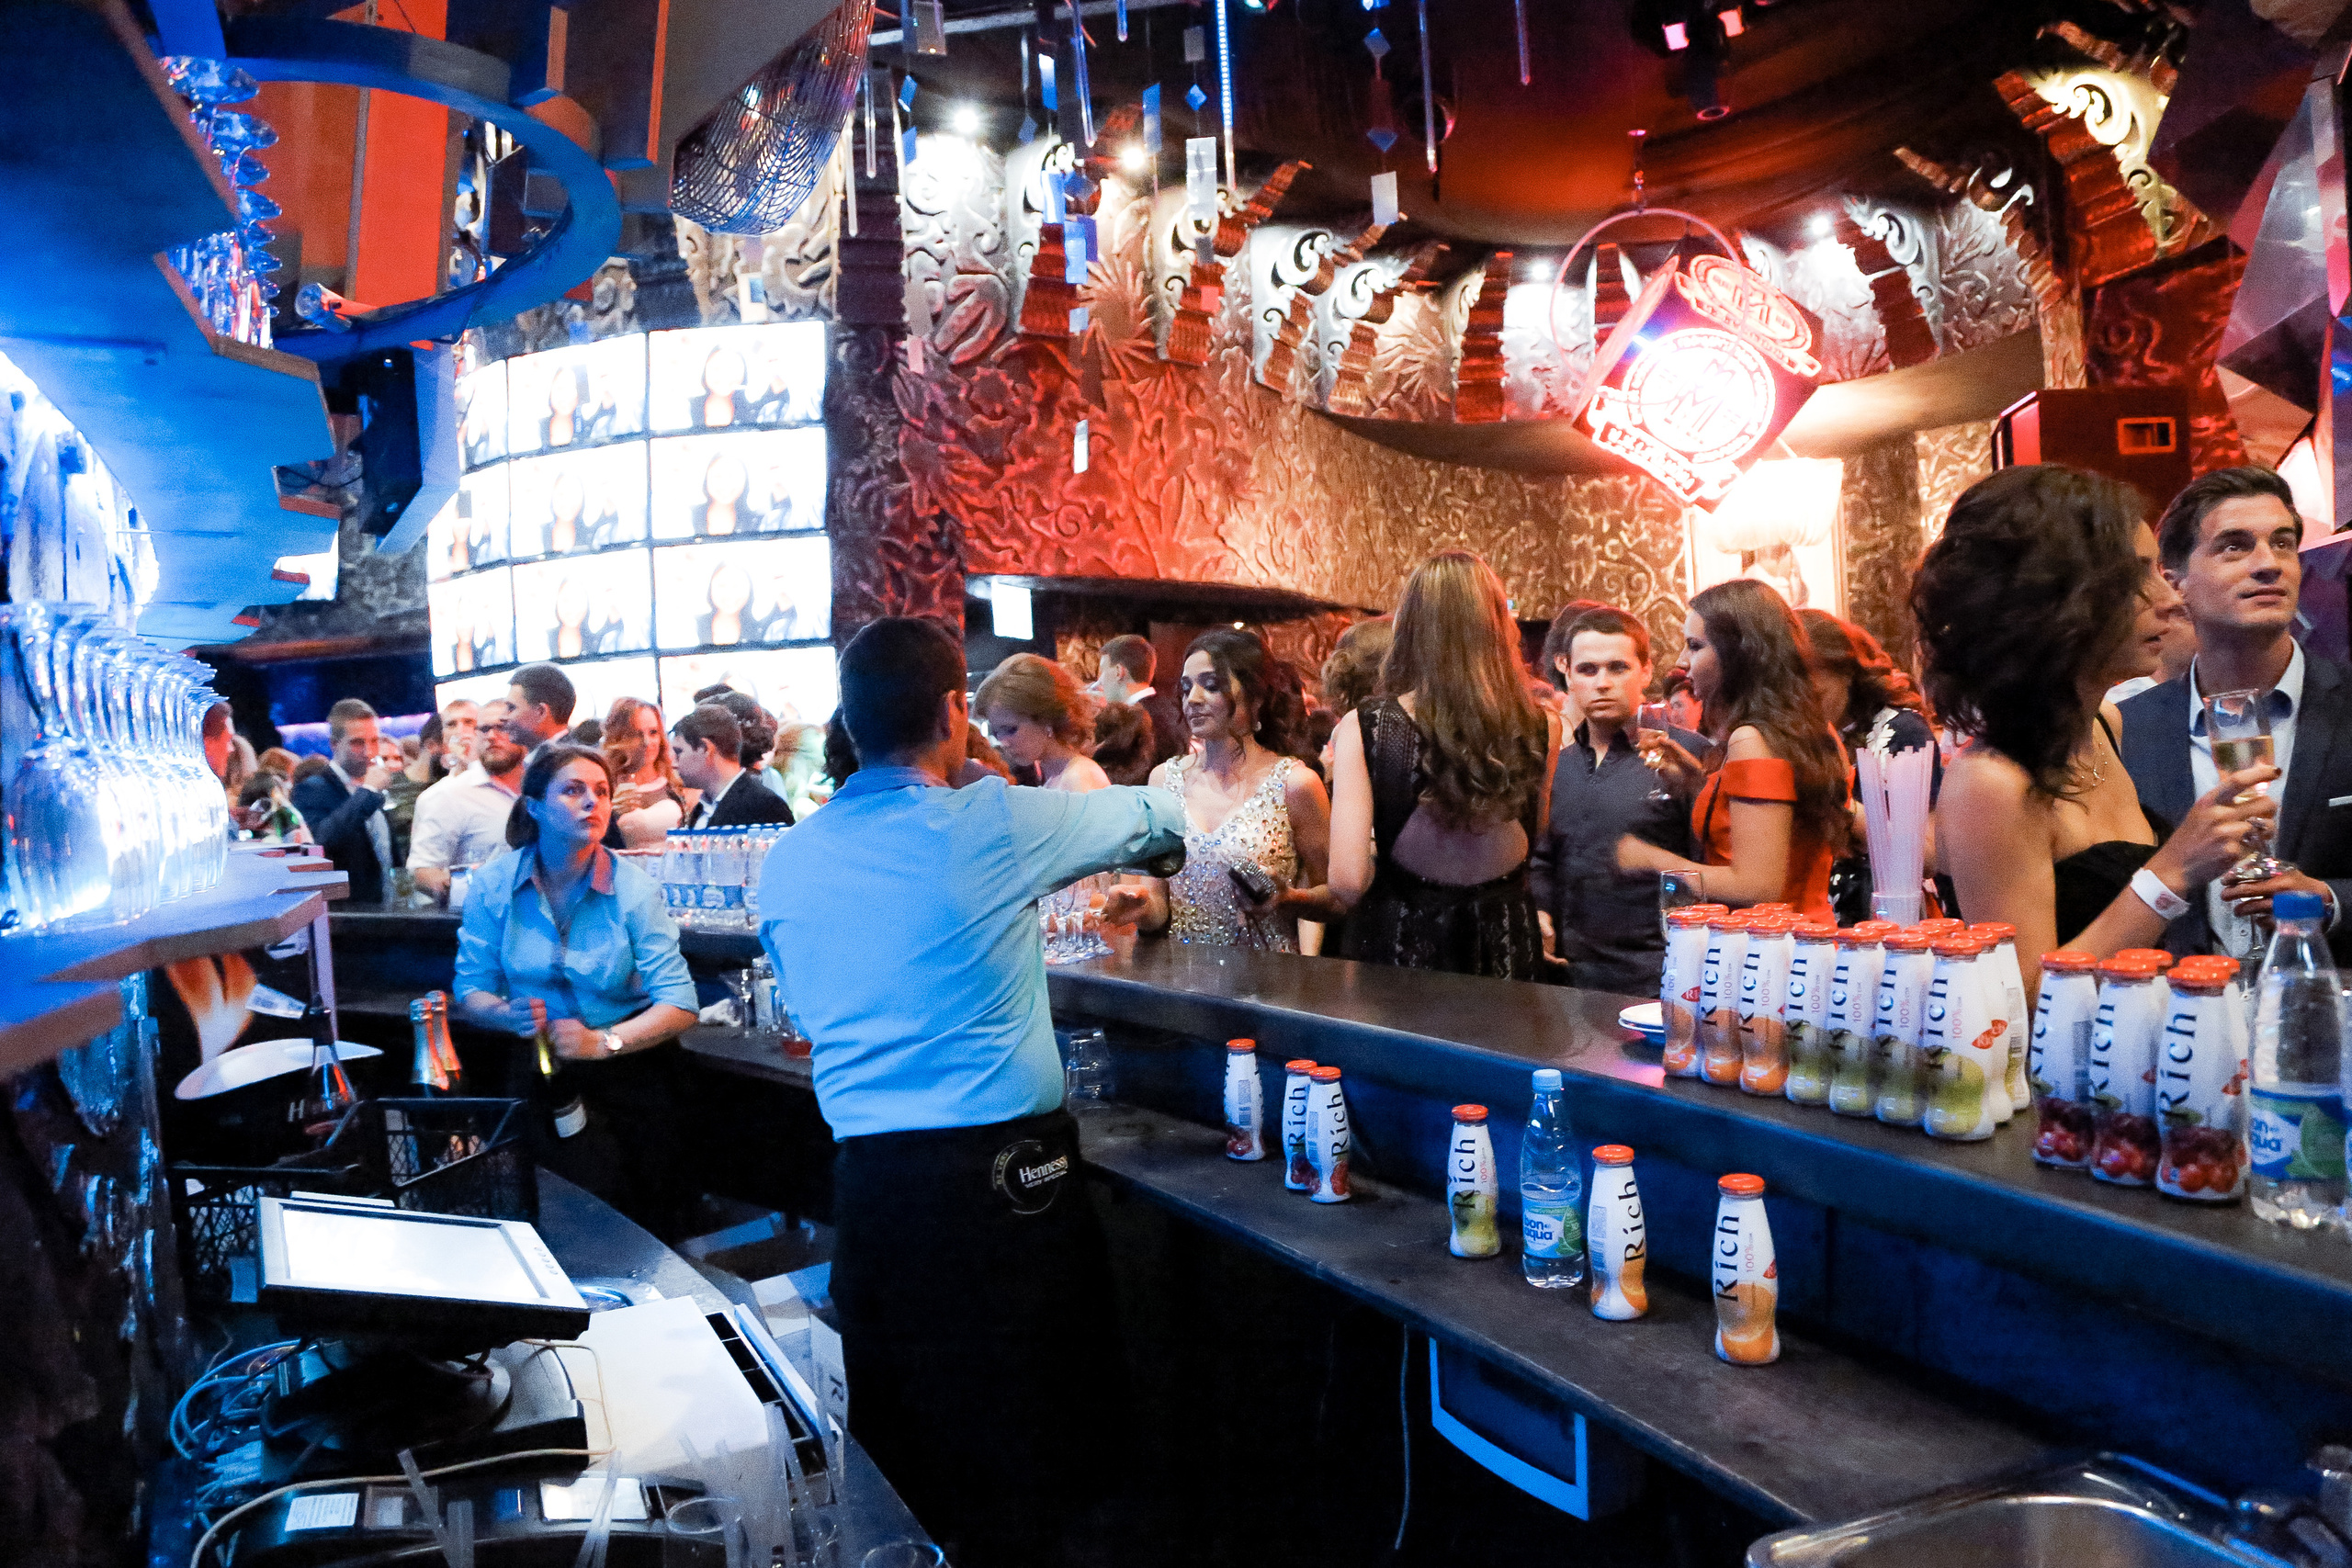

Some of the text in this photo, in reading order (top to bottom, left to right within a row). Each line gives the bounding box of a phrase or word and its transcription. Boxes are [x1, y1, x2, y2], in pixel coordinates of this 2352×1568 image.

[2159, 1013, 2197, 1120] Rich
[1288, 1087, 1306, 1146] Rich
[1327, 1093, 1348, 1156] Rich
[1453, 1139, 1476, 1209] Rich
[1618, 1179, 1645, 1262] Rich
[1715, 1215, 1739, 1302] Rich
